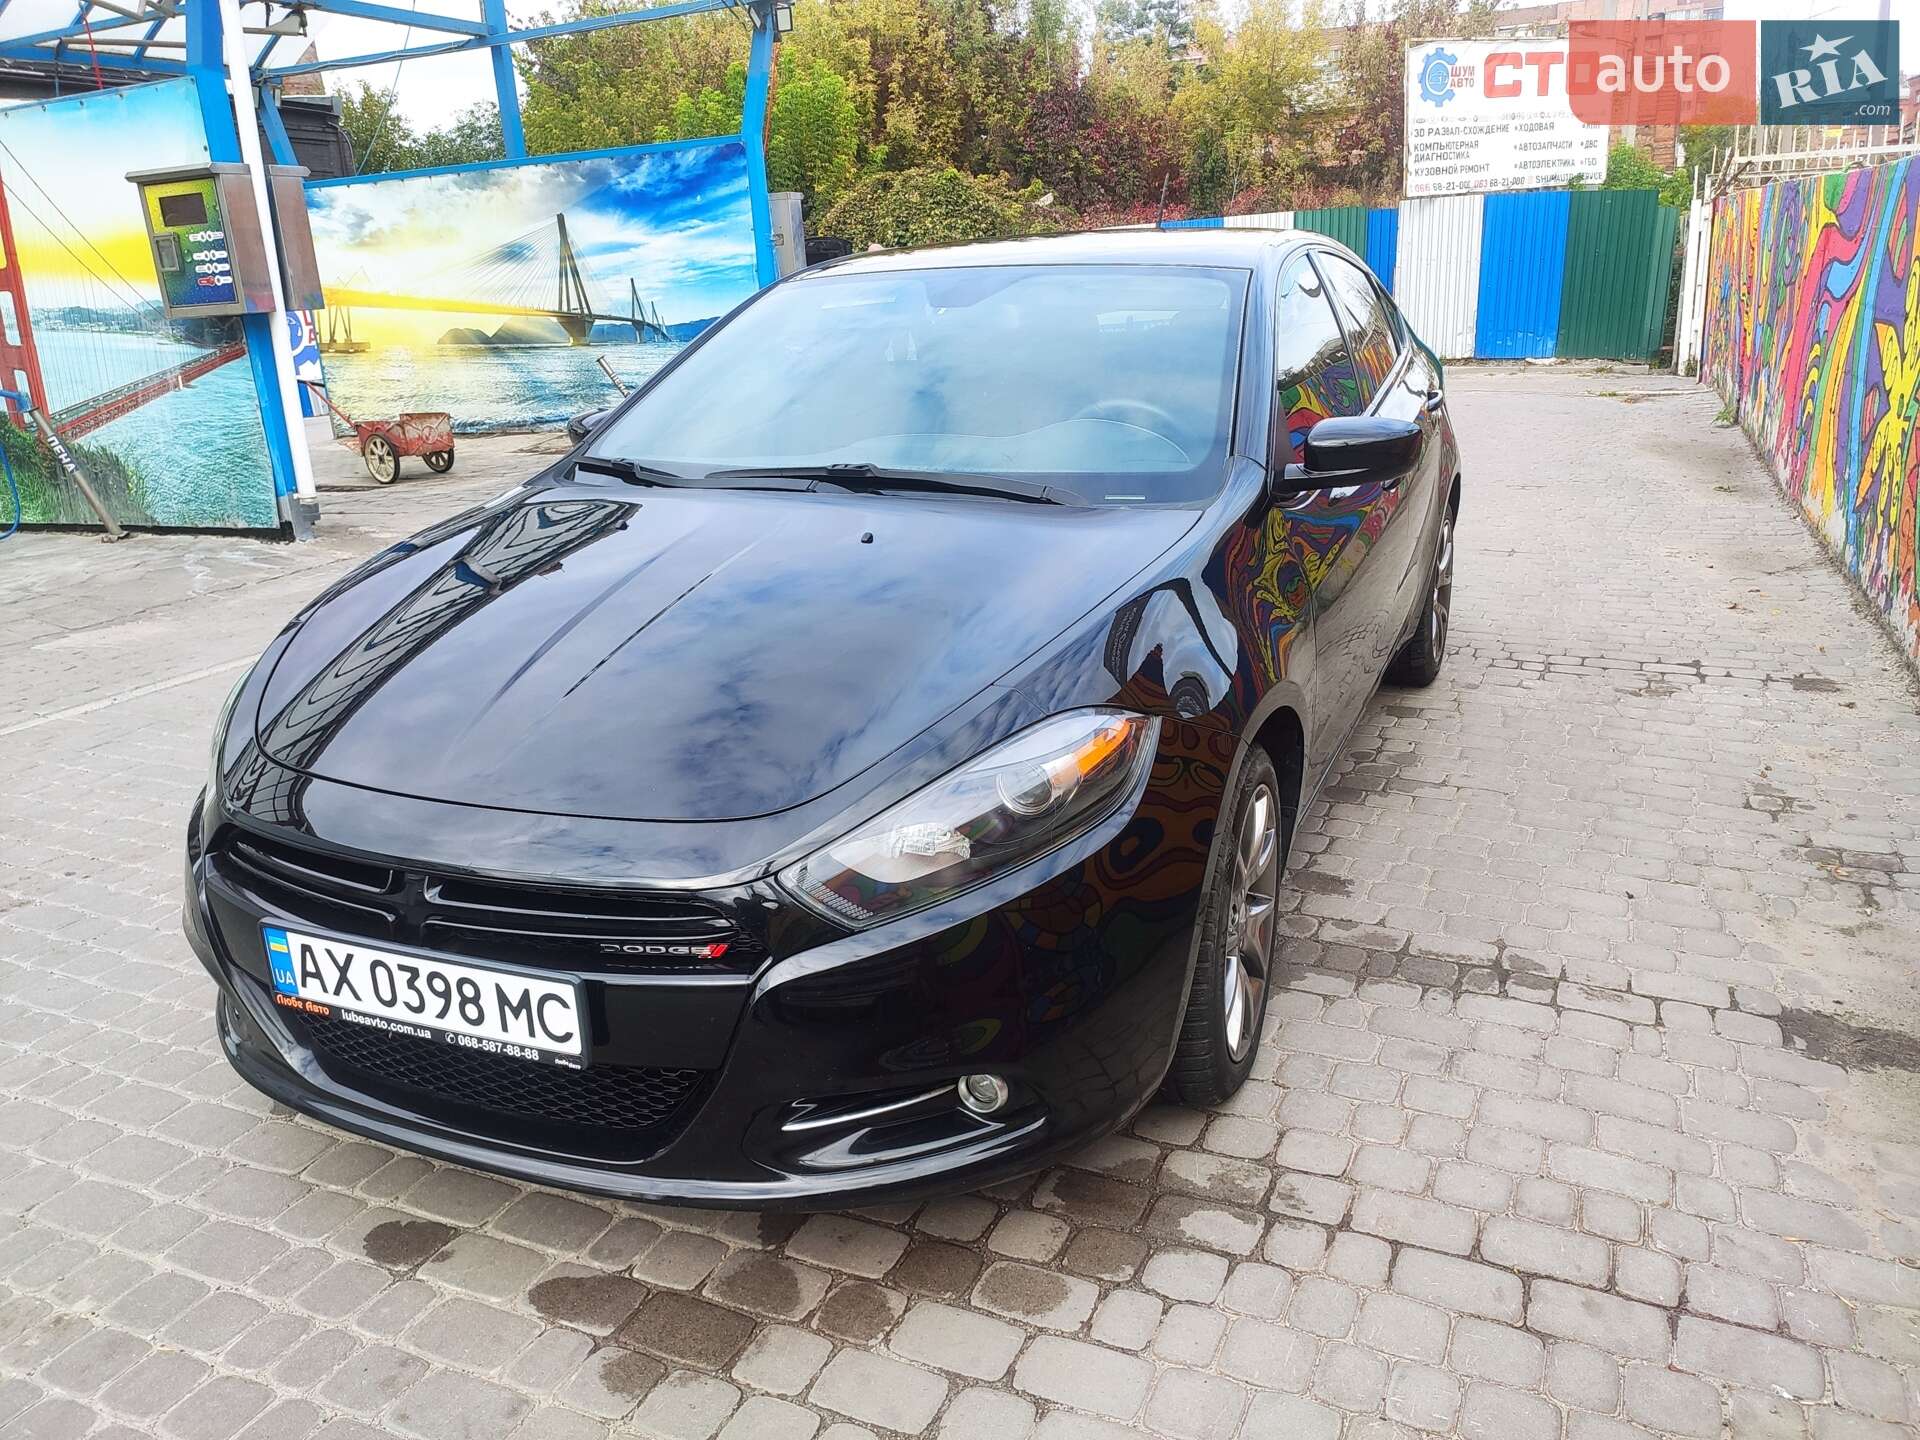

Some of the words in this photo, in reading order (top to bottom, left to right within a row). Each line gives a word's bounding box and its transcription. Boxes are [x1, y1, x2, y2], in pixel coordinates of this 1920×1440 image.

[1450, 65, 1475, 78] ШУМ
[1450, 77, 1475, 89] АВТО
[1414, 140, 1479, 152] КОМПЬЮТЕРНАЯ
[1414, 151, 1470, 163] ДИАГНОСТИКА
[1414, 164, 1458, 176] КУЗОВНОЙ
[1459, 163, 1490, 174] РЕМОНТ
[47, 436, 76, 473] ПЕНА
[600, 943, 712, 956] DODGE
[274, 967, 296, 986] UA
[300, 943, 362, 1002] AX
[369, 959, 485, 1027] 0398
[495, 982, 574, 1044] MC
[341, 1009, 431, 1039] lubeavto.com.ua
[458, 1036, 540, 1061] 068-587-88-88
